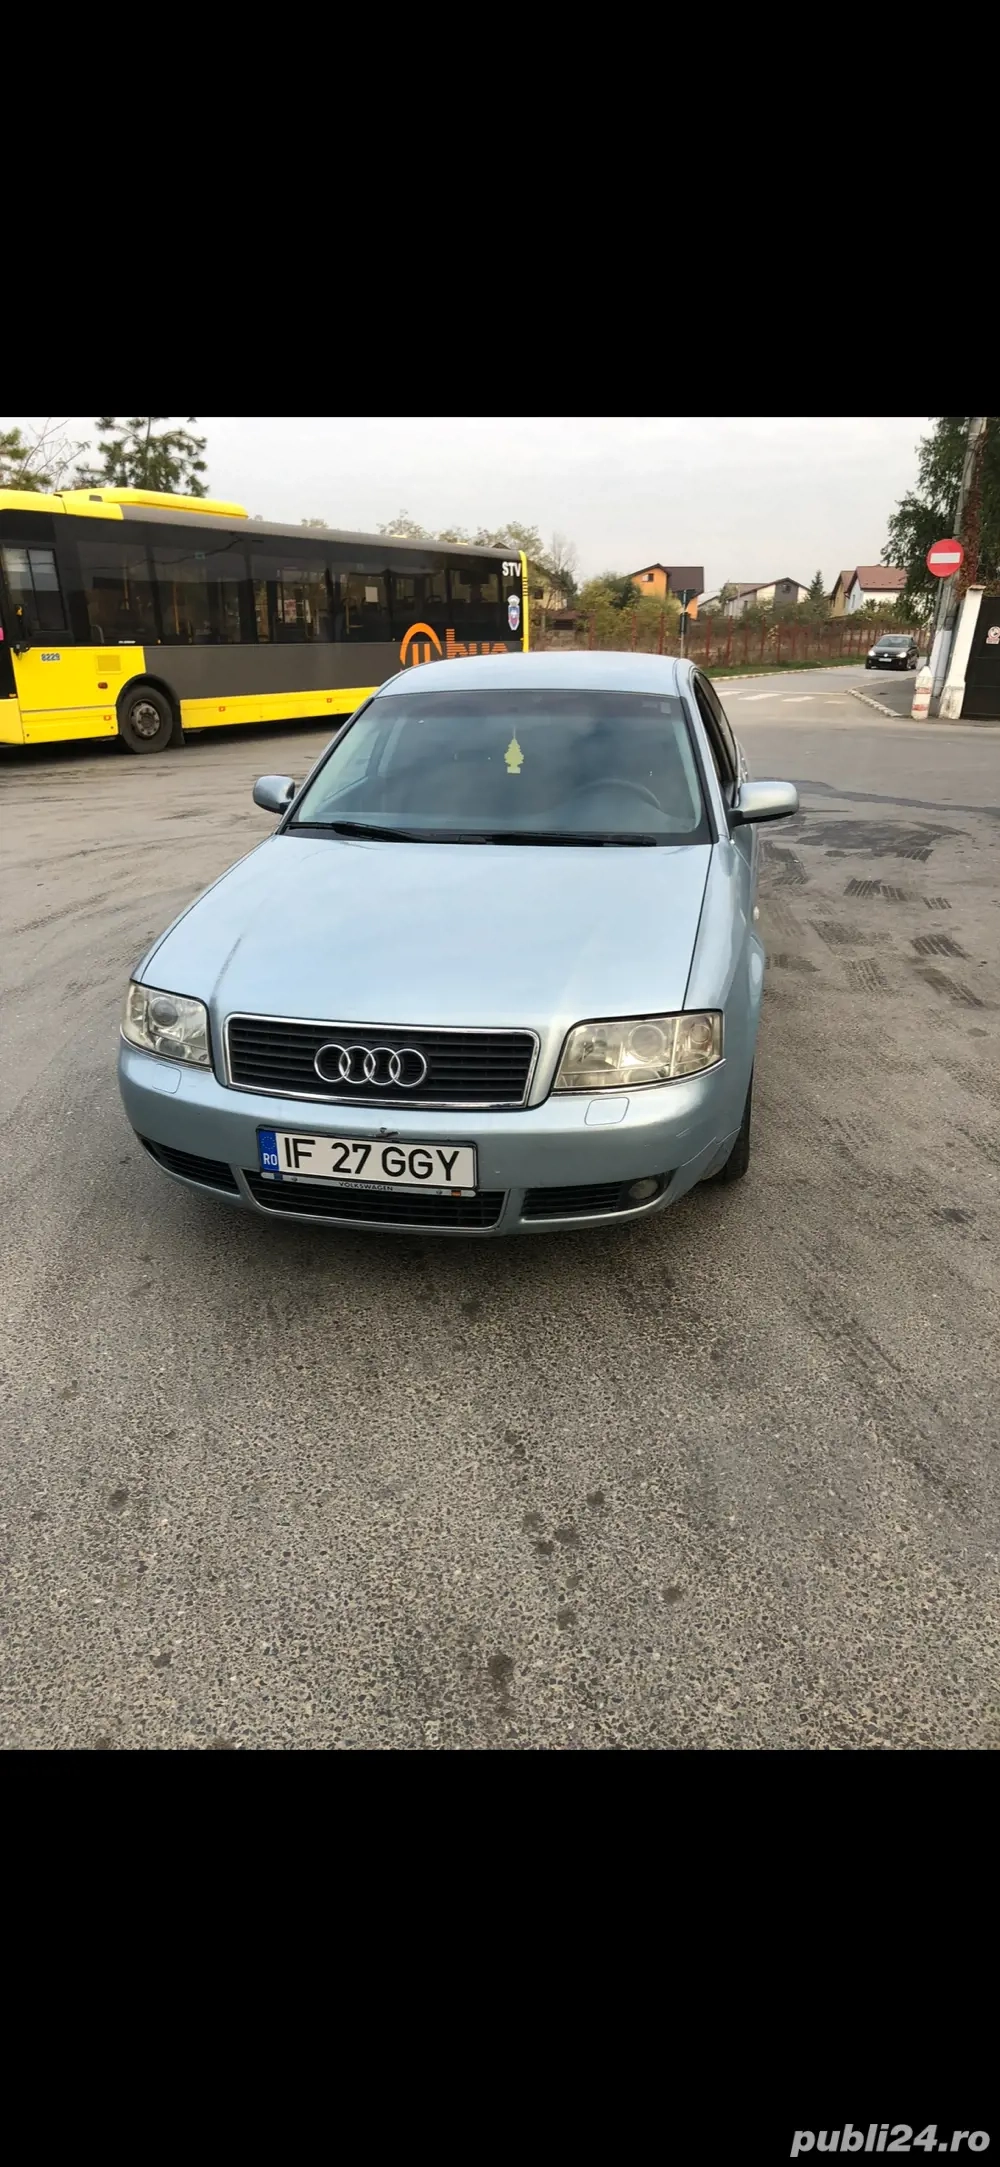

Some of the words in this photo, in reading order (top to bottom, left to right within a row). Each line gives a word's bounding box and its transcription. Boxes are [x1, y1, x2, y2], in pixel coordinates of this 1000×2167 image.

[502, 561, 521, 577] STV
[263, 1152, 278, 1167] RO
[285, 1137, 315, 1168] IF
[331, 1142, 371, 1174] 27
[381, 1146, 460, 1181] GGY
[338, 1181, 394, 1192] VOLKSWAGEN
